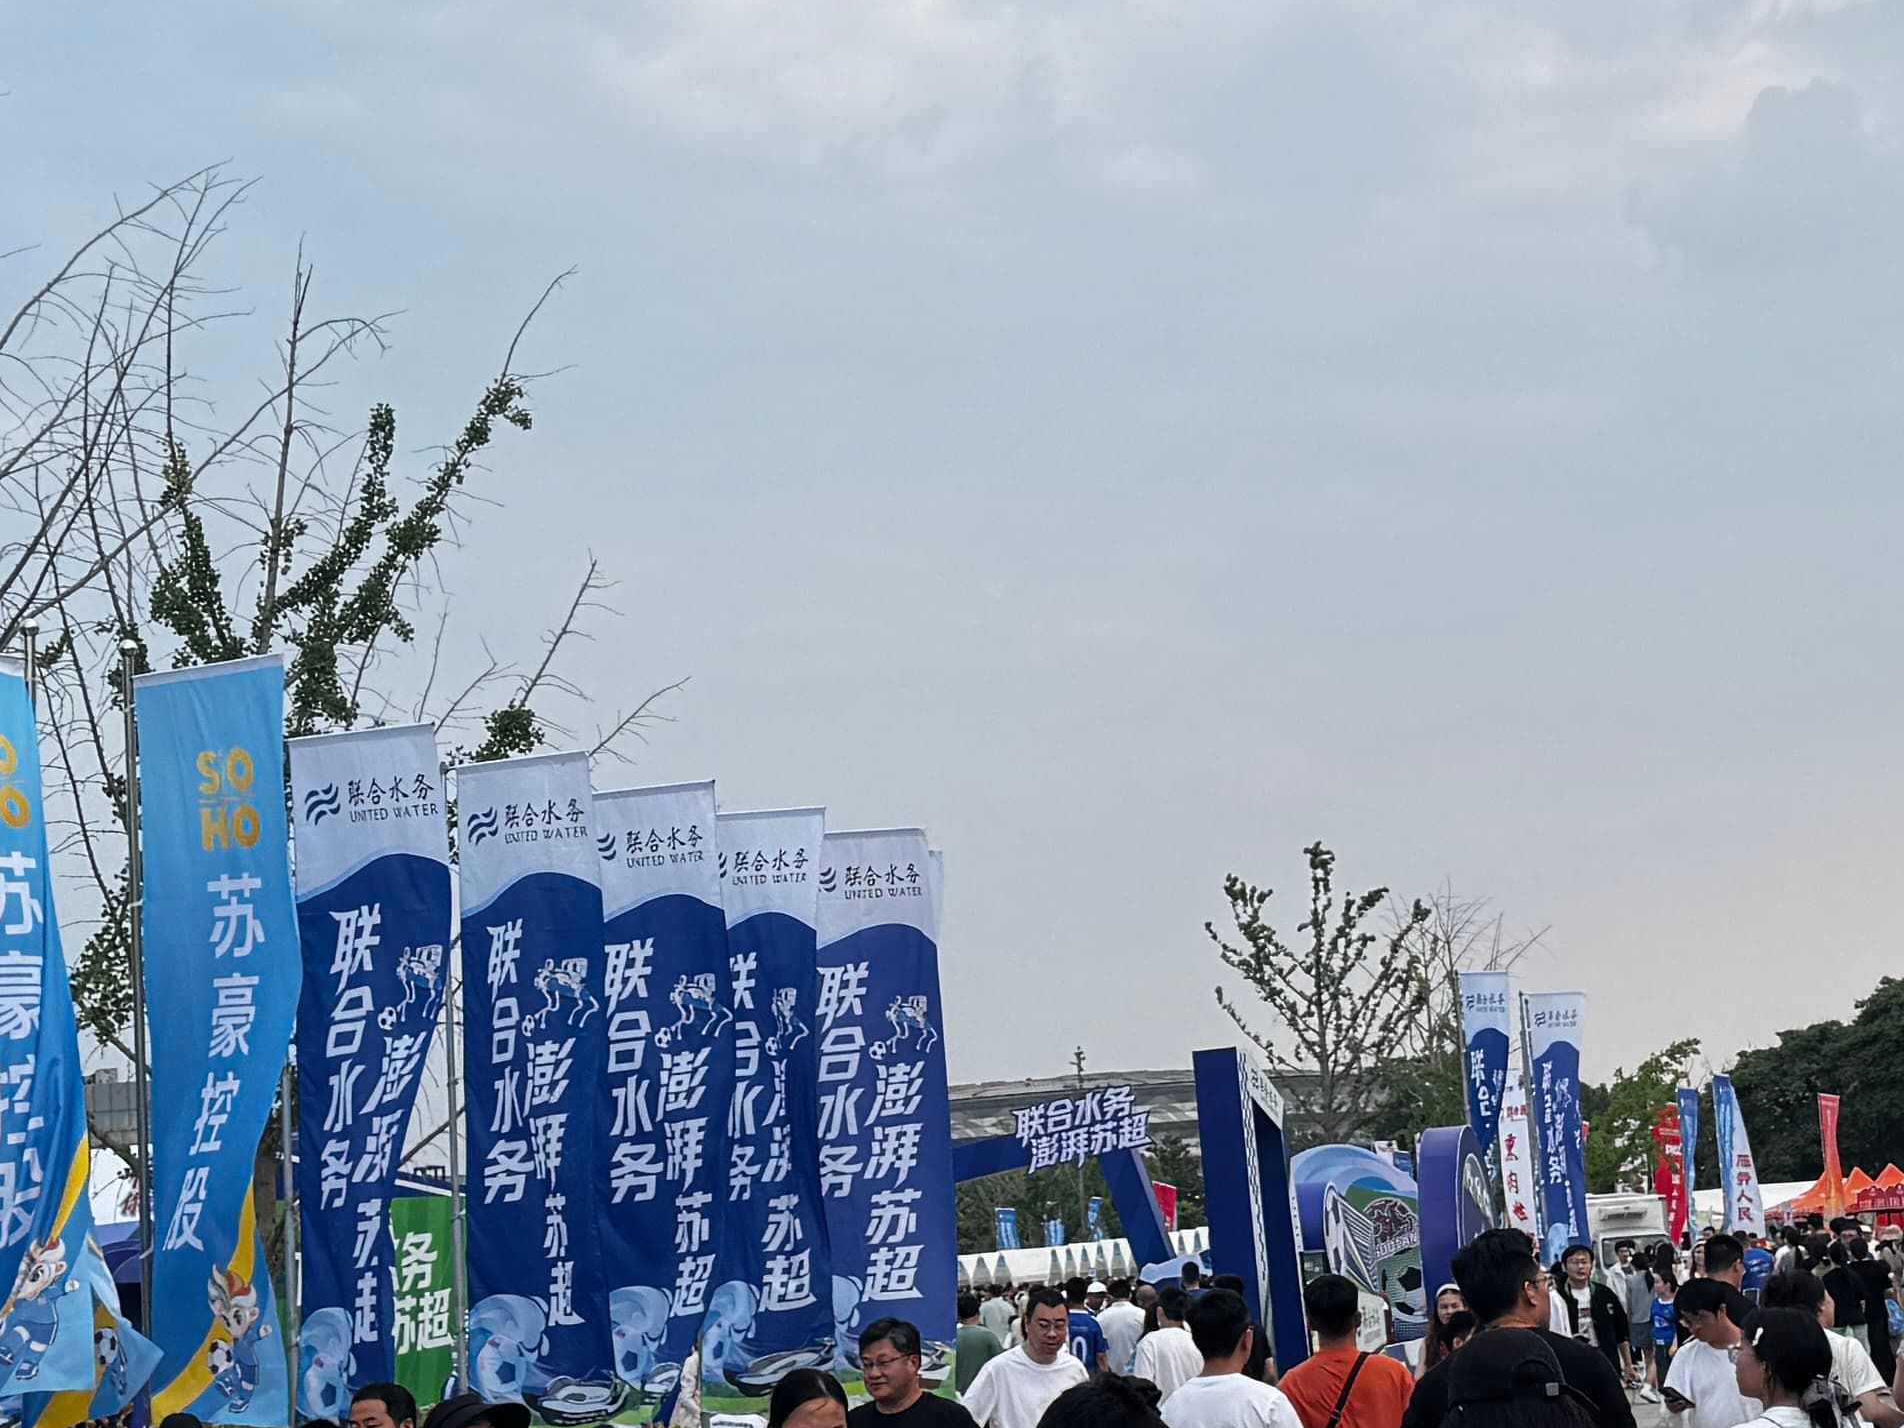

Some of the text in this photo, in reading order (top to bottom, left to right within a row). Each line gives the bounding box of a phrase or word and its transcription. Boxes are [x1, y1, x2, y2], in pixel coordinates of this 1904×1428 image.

[347, 773, 435, 806] 联合水务
[350, 803, 439, 824] UNITED WATER
[504, 798, 584, 828] 联合水务
[504, 825, 588, 845] UNITED WATER
[626, 824, 704, 854] 联合水务
[626, 850, 704, 869] UNITED WATER
[734, 848, 809, 872] 联合水务
[844, 866, 921, 888] 联合水务
[844, 885, 922, 900] UNITED WATER
[163, 873, 266, 1252] 苏豪控股
[320, 902, 383, 1211] 联合水务
[484, 918, 535, 1205] 联合水务
[604, 937, 664, 1204] 联合水务
[816, 960, 869, 1199] 联合水务
[1012, 1085, 1135, 1146] 联合水务
[1028, 1112, 1155, 1173] 澎湃苏超
[522, 1036, 586, 1327] 澎湃苏超
[655, 1046, 716, 1318] 澎湃苏超
[863, 1059, 925, 1303] 澎湃苏超
